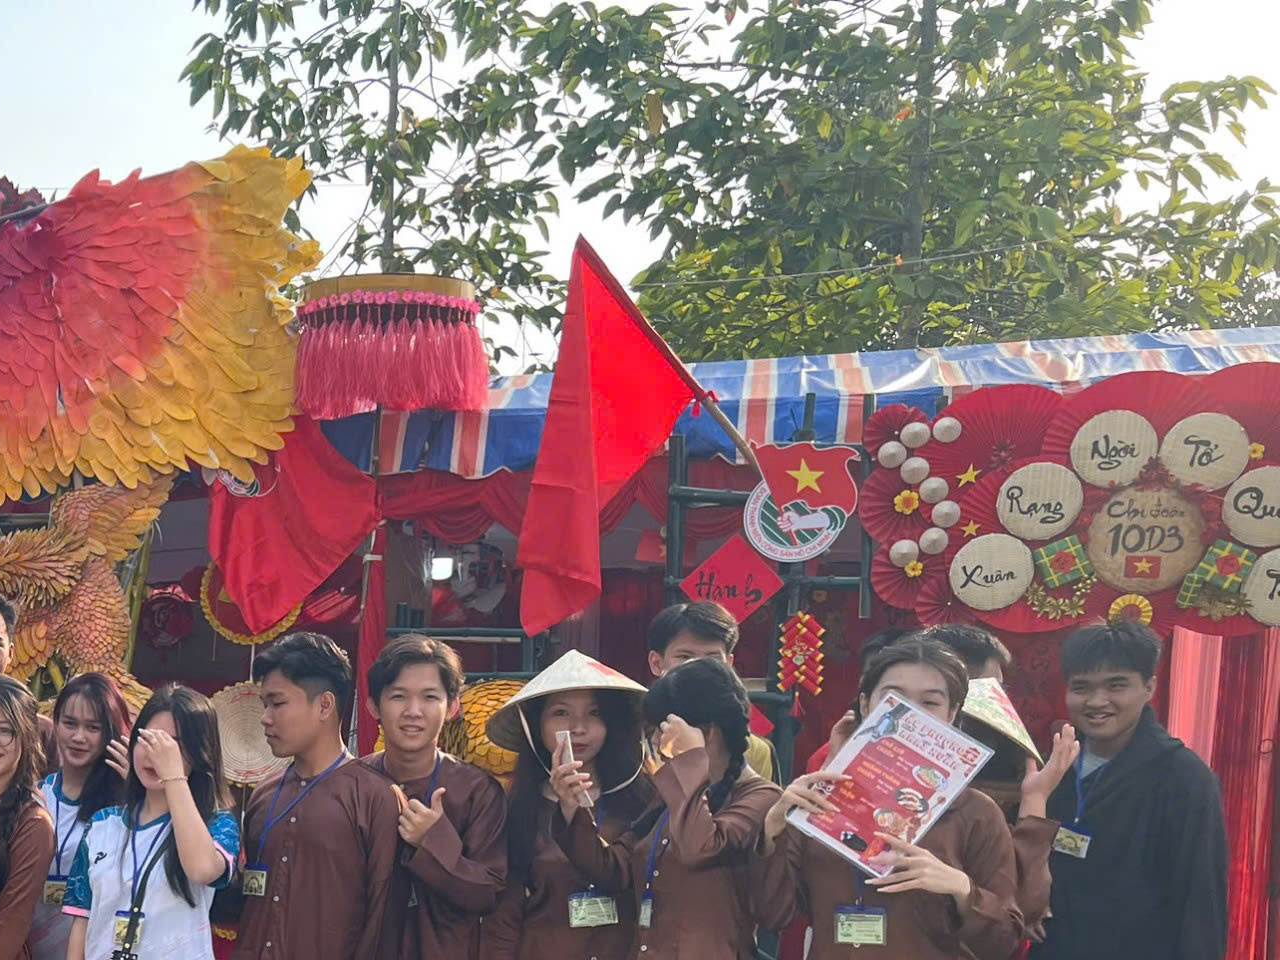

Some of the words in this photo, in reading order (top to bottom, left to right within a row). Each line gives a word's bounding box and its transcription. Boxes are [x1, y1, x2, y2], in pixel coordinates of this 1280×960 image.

[960, 564, 1018, 589] Xuân
[1006, 486, 1065, 524] Rạng
[1183, 435, 1224, 468] Tổ
[1107, 523, 1185, 557] 10D3
